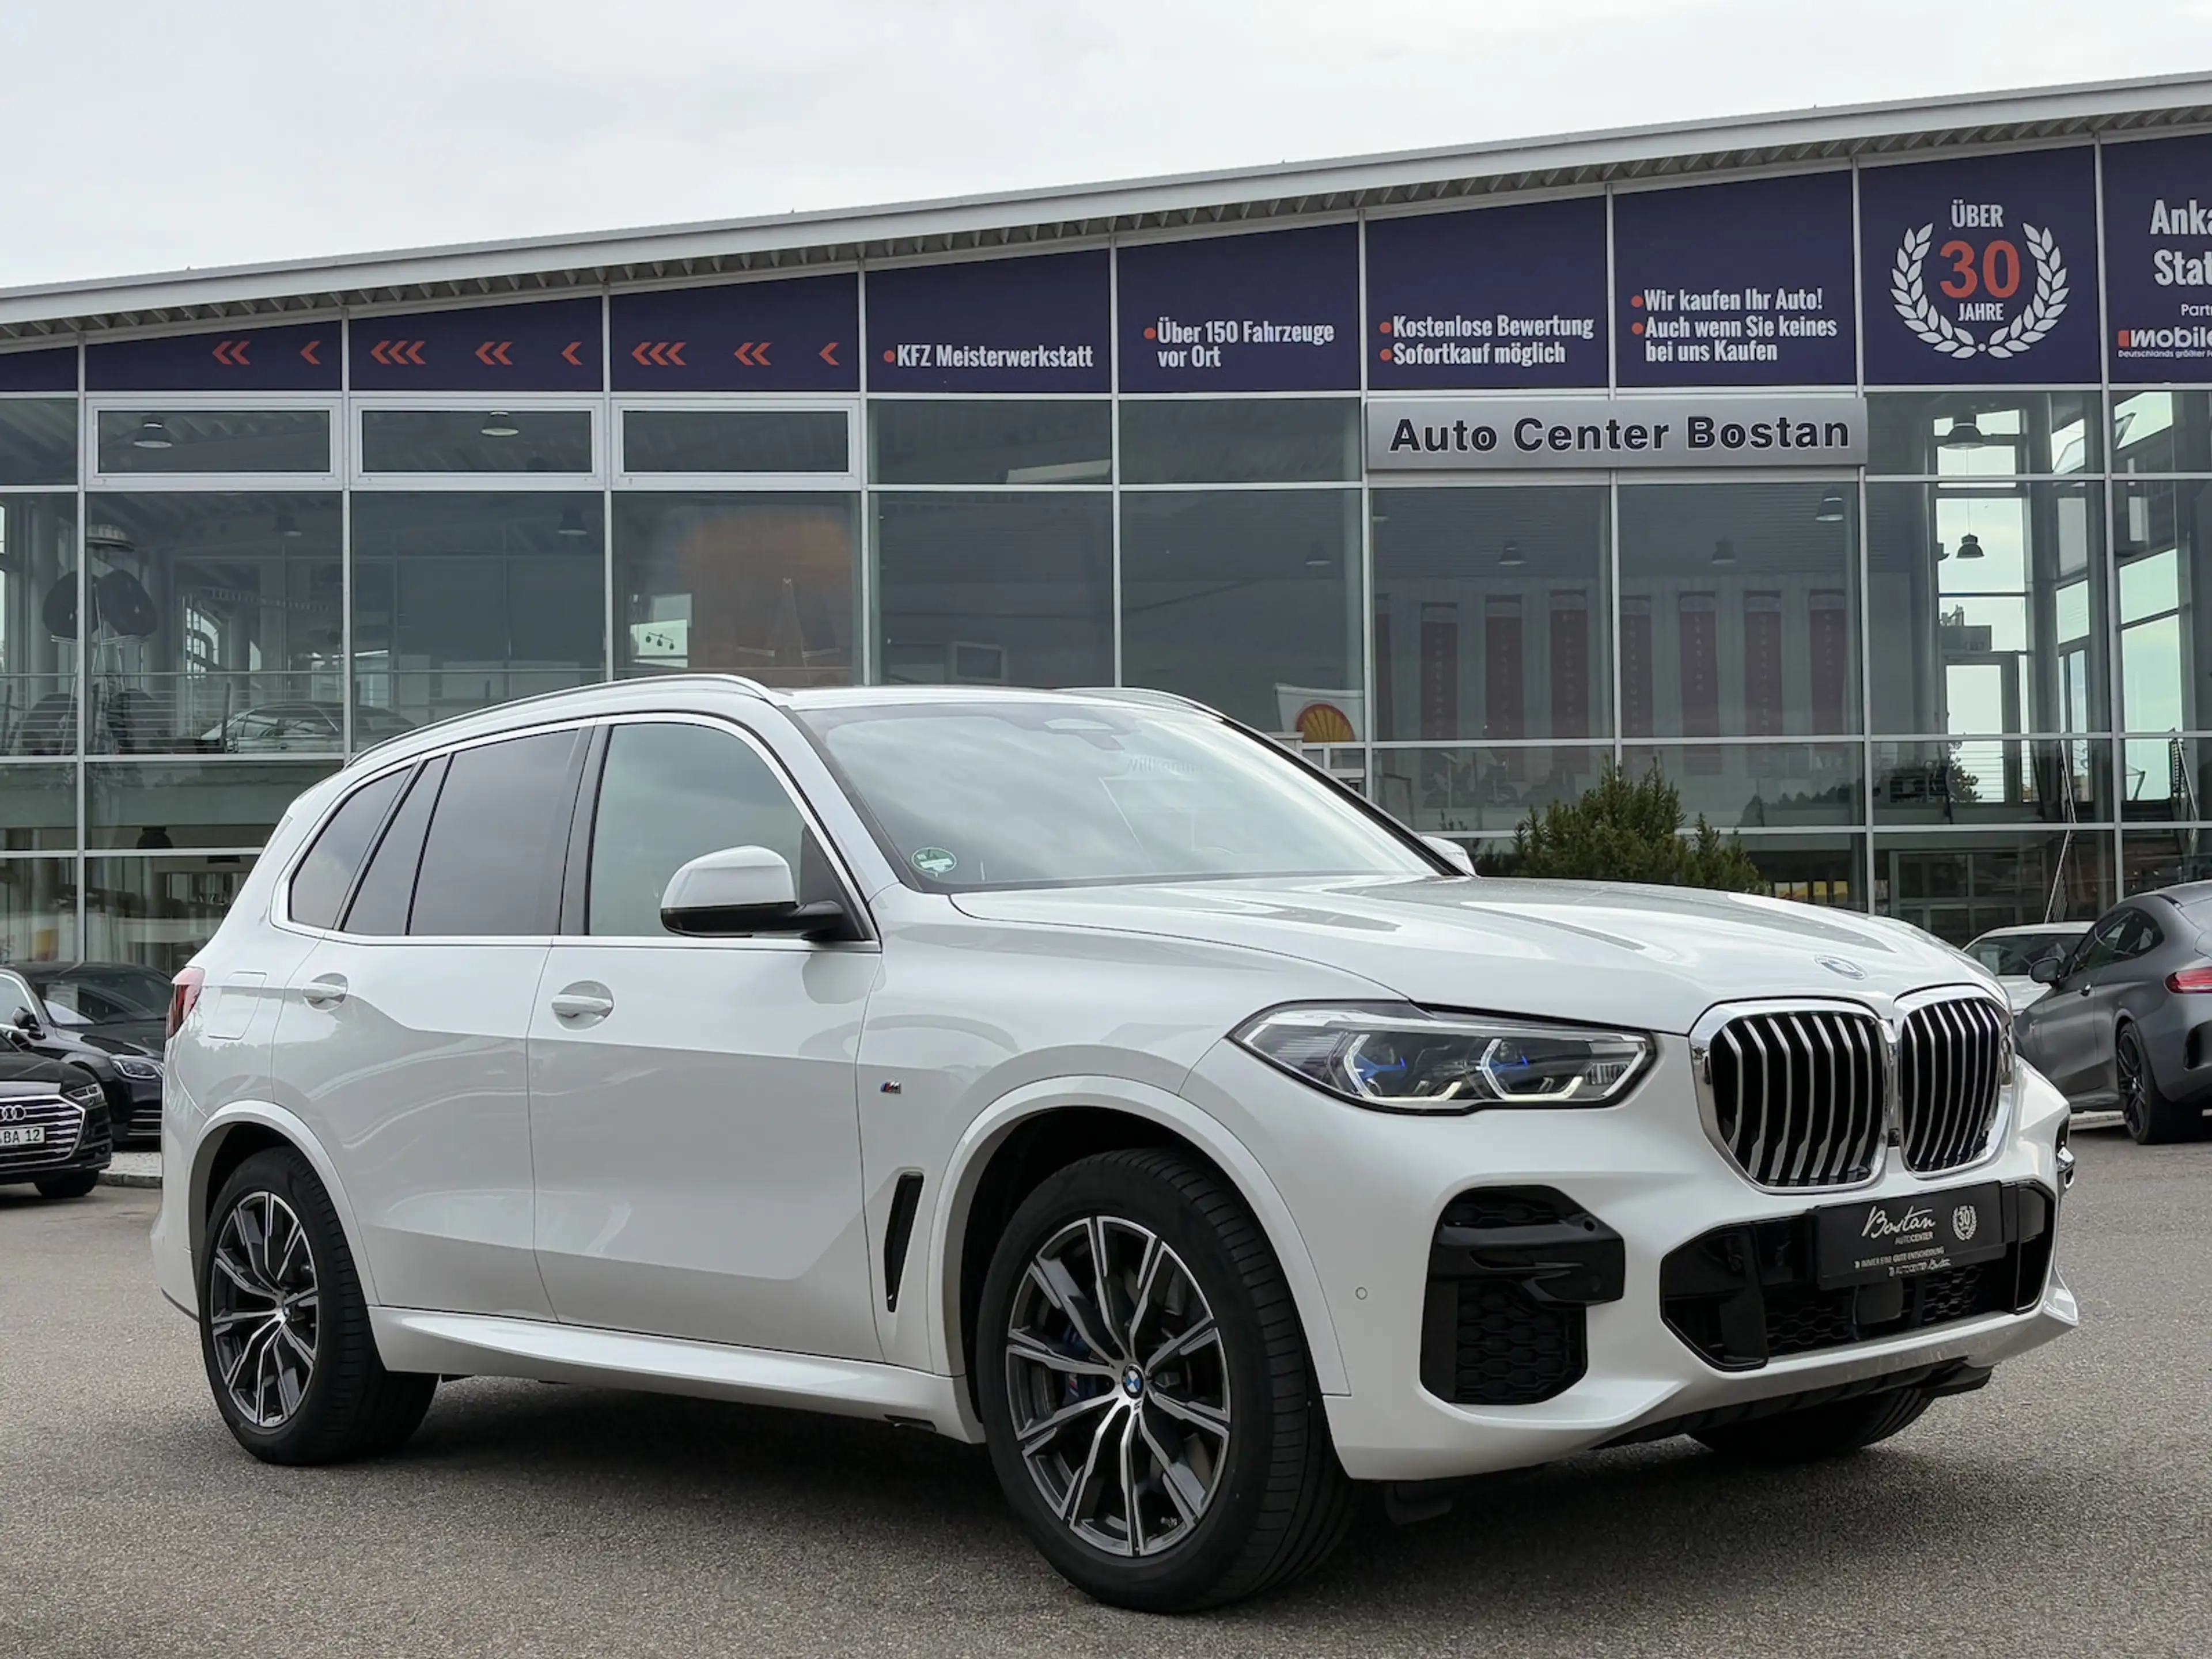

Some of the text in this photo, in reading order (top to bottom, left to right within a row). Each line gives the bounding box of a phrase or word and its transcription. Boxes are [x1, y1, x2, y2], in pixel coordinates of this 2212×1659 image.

[1951, 199, 2004, 228] ÜBER
[1940, 240, 2020, 298] 30
[1644, 287, 1823, 311] Wir kaufen Ihr Auto!
[2180, 303, 2212, 317] Part
[1957, 302, 2004, 321] JAHRE
[1157, 317, 1335, 346] Über 150 Fahrzeuge
[1393, 315, 1594, 339] Kostenlose Bewertung
[1645, 315, 1838, 338] Auch wenn Sie keines
[897, 344, 1093, 368] KFZ Meisterwerkstatt
[1157, 344, 1222, 368] vor Ort
[1393, 341, 1566, 367] Sofortkauf möglich
[1645, 339, 1778, 362] bei uns Kaufen
[1388, 416, 1850, 453] Auto Center Bostan
[24, 1129, 41, 1142] 12
[1861, 1205, 1936, 1239] Bostan
[1957, 1210, 1971, 1226] 30
[1894, 1230, 1934, 1245] AUTOCENTER
